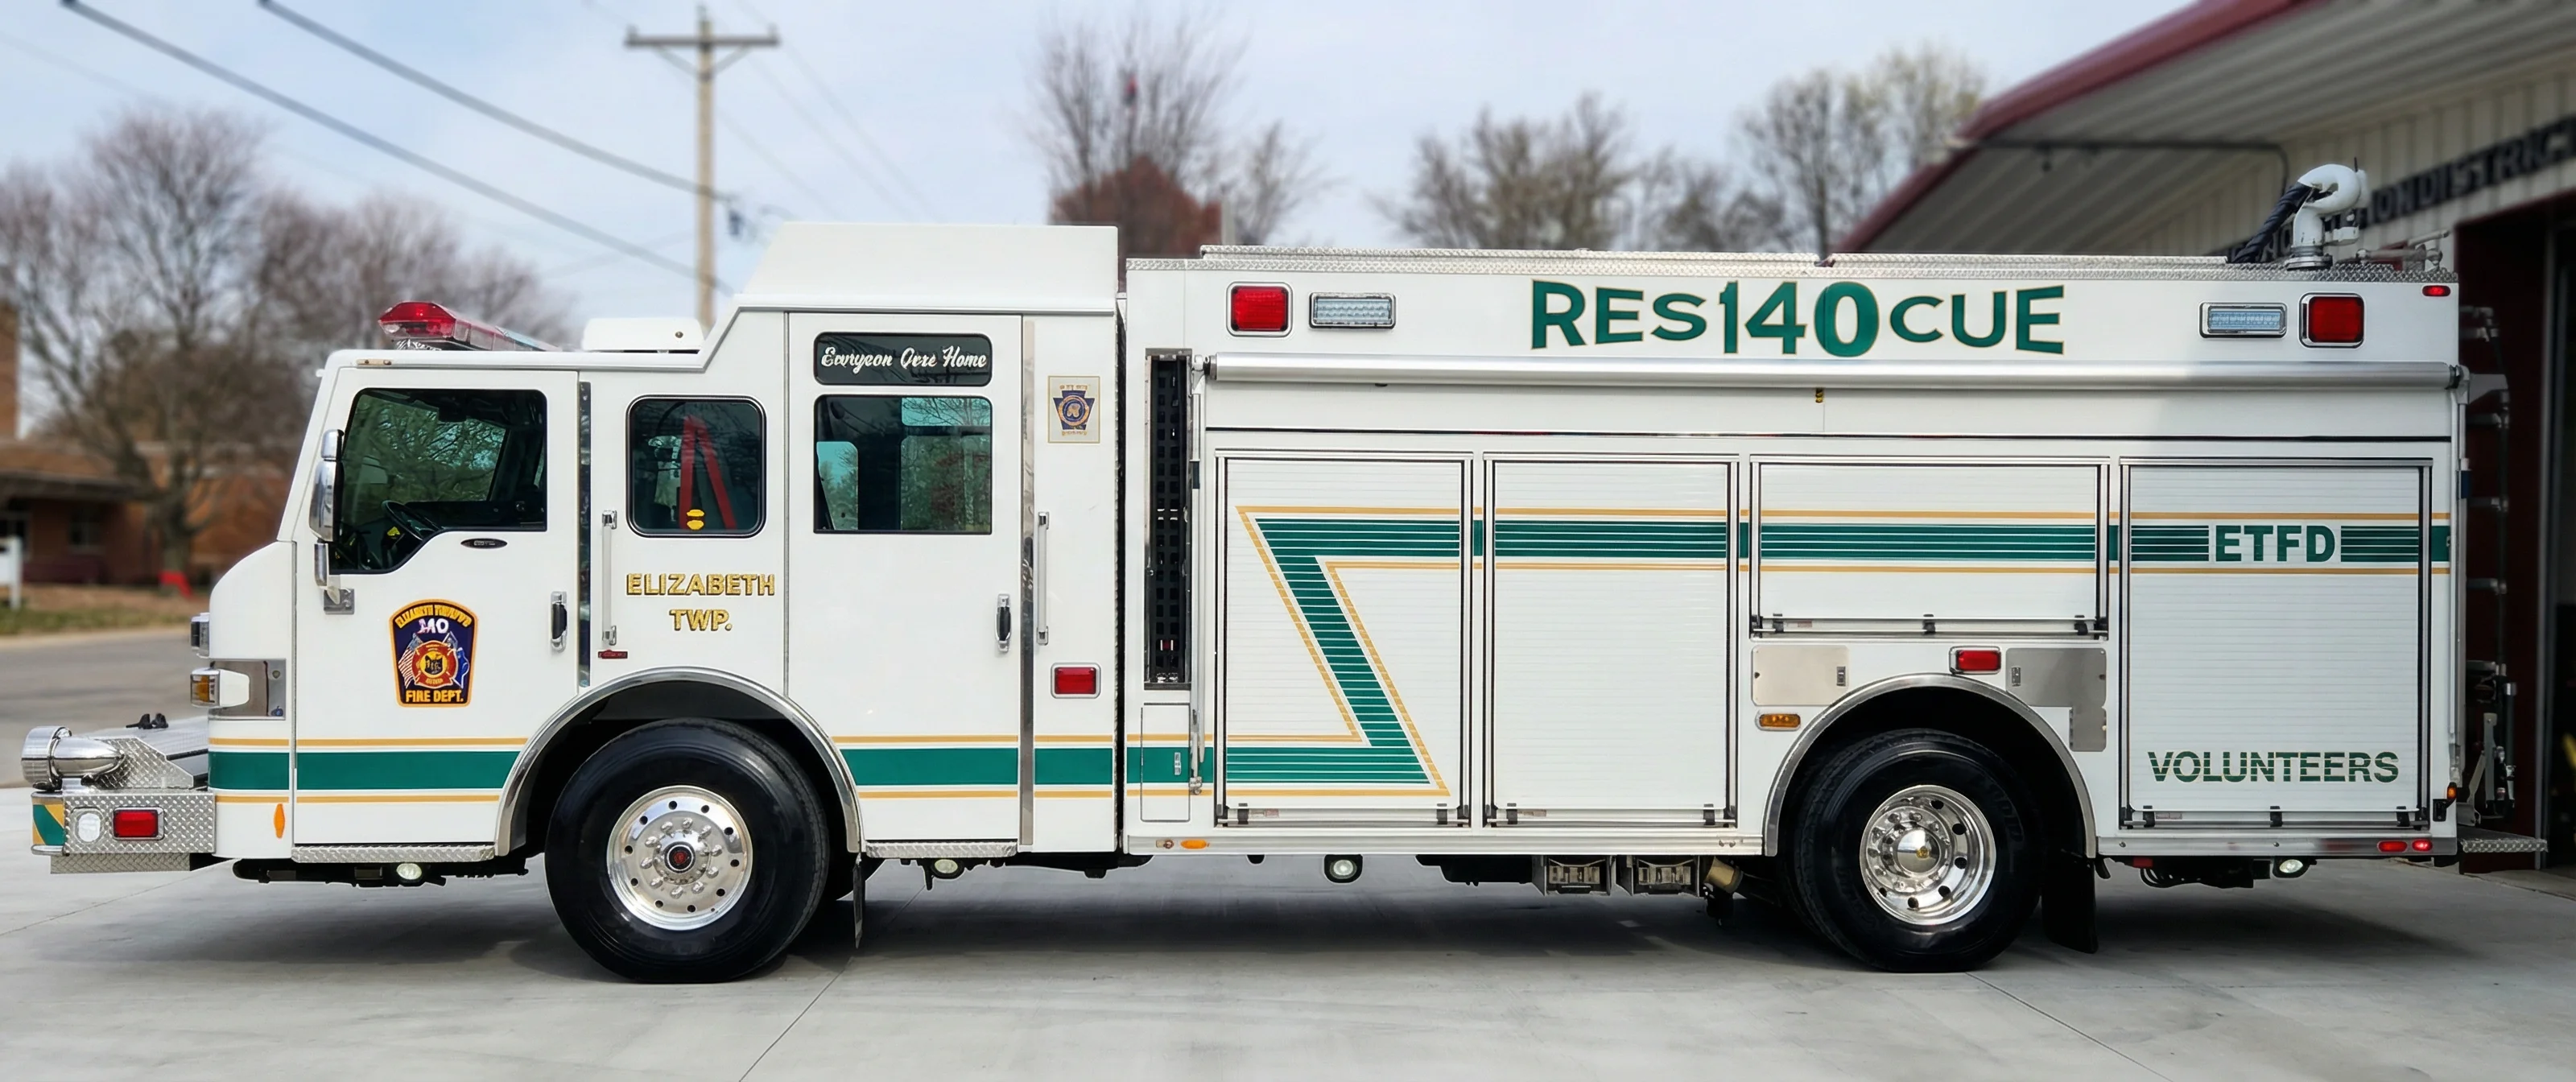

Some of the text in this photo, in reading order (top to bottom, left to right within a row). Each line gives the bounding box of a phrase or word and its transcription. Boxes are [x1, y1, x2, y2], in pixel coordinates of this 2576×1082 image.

[2417, 114, 2576, 209] DISTRIC
[942, 345, 987, 368] Home
[2216, 525, 2335, 562] ETFD
[626, 572, 774, 596] ELIZABETH
[669, 609, 733, 631] TWP.
[406, 690, 464, 702] FIRE DEPT.
[2148, 750, 2399, 783] VOLUNTEERS
